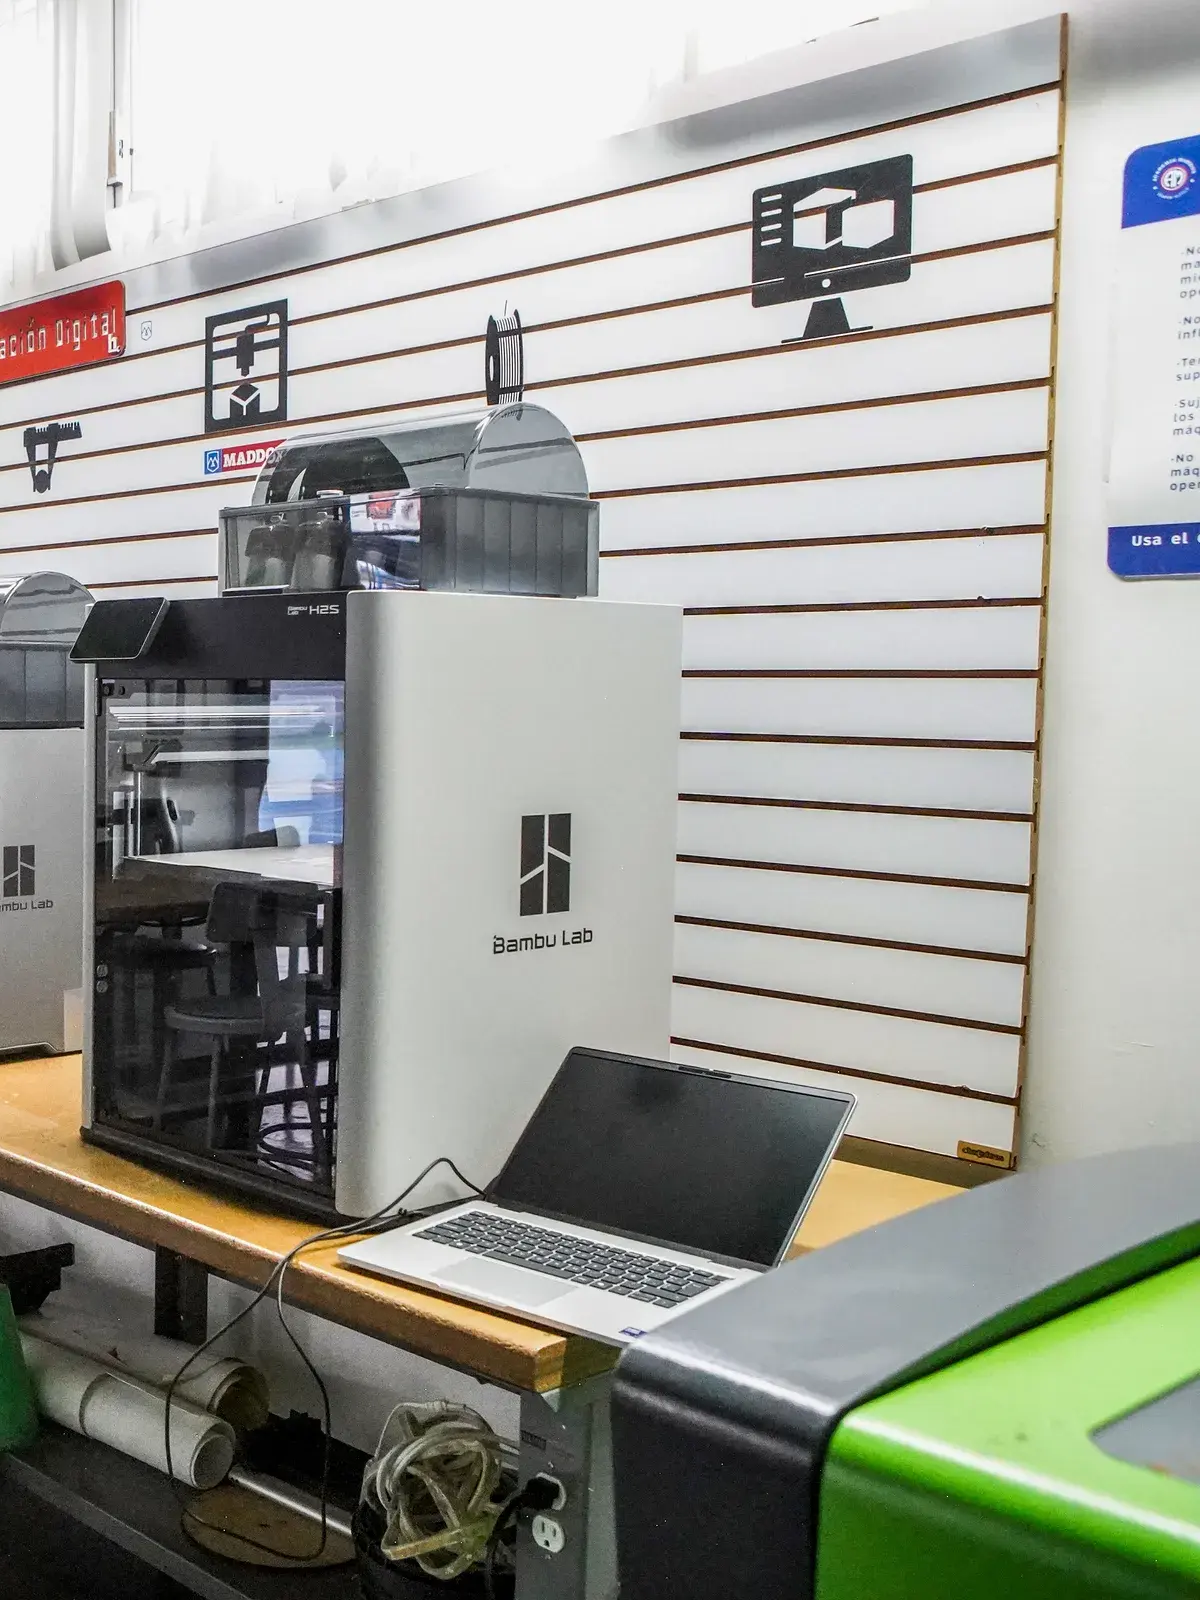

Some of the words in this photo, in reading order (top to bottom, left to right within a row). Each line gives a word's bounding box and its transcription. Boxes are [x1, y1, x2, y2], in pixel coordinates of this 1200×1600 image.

[1180, 273, 1200, 284] mi
[1180, 289, 1200, 299] op
[56, 307, 116, 351] Digital
[1173, 413, 1194, 422] los
[1131, 535, 1162, 547] Usa
[1171, 532, 1188, 545] el
[309, 604, 340, 615] H2S
[31, 899, 54, 910] Lab
[493, 934, 556, 954] Bambu
[562, 928, 593, 945] Lab
